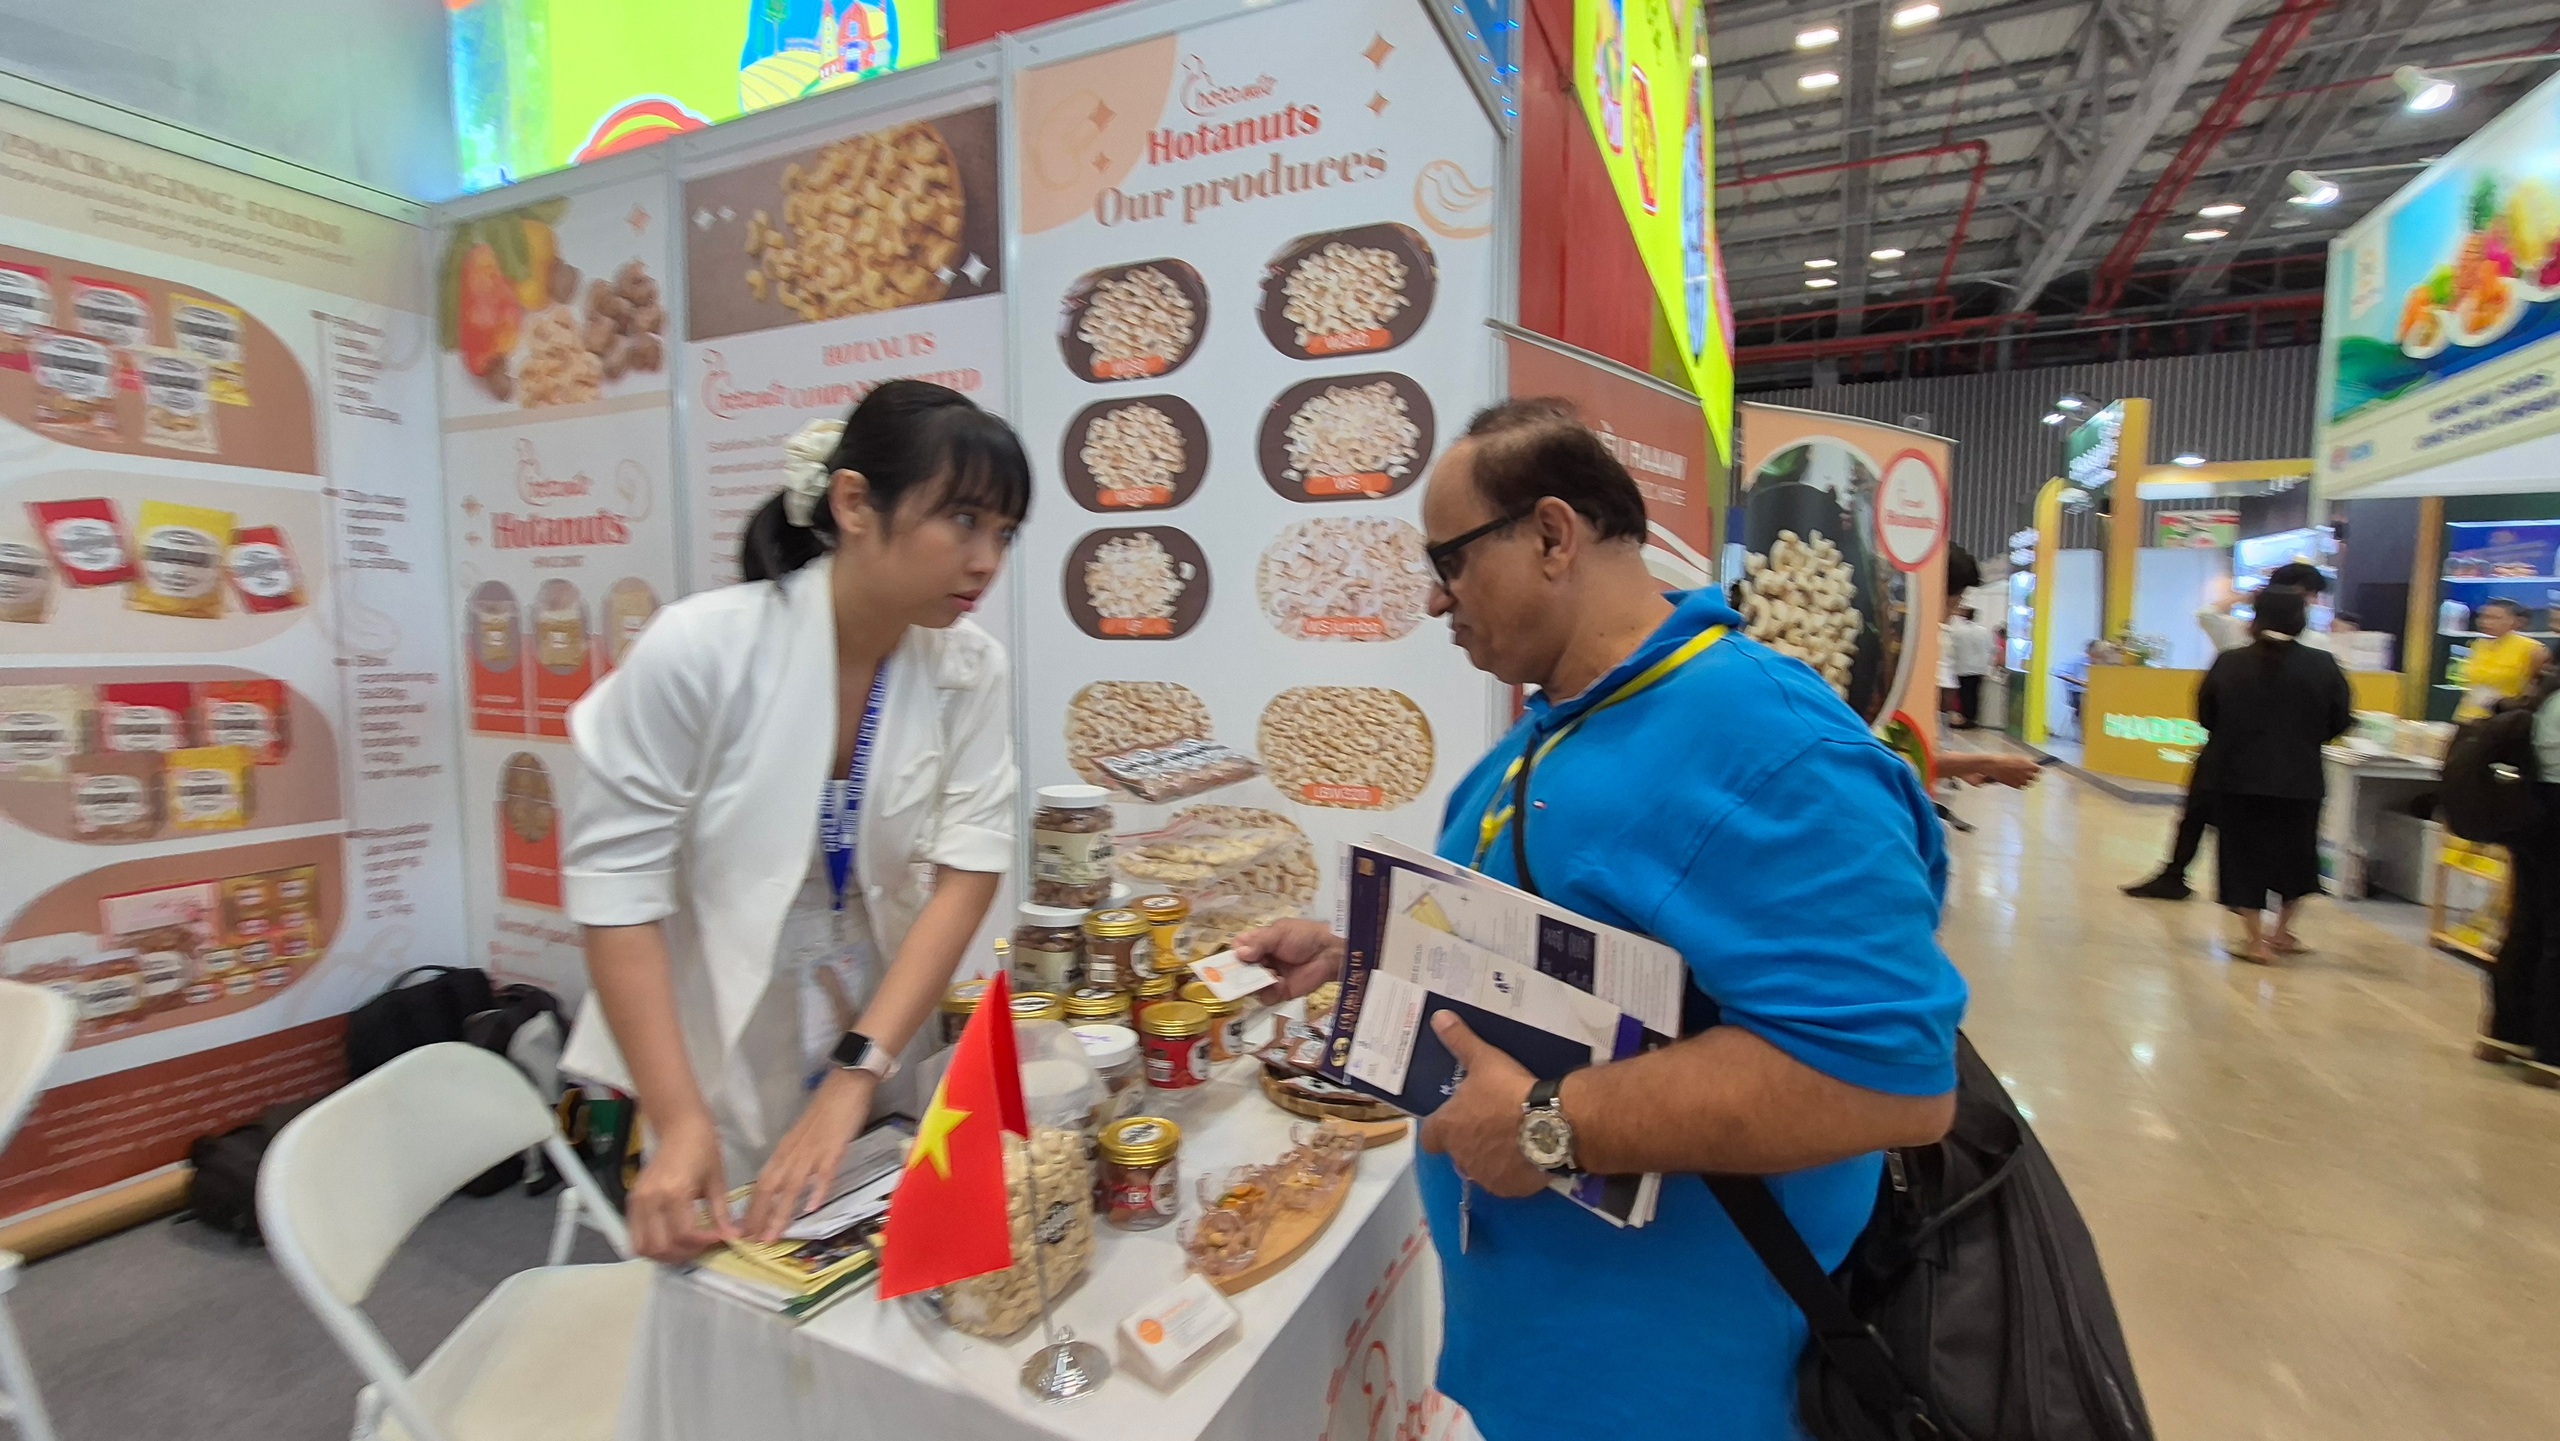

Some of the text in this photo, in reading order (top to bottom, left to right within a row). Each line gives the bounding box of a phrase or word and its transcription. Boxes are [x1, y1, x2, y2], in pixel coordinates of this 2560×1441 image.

[1146, 103, 1323, 167] Hotanuts
[3, 130, 238, 216] PACKAGING
[248, 200, 343, 246] FORM
[1093, 147, 1388, 227] Our produces
[1334, 475, 1362, 491] WS
[489, 507, 632, 549] Hotanuts
[358, 672, 439, 685] containing
